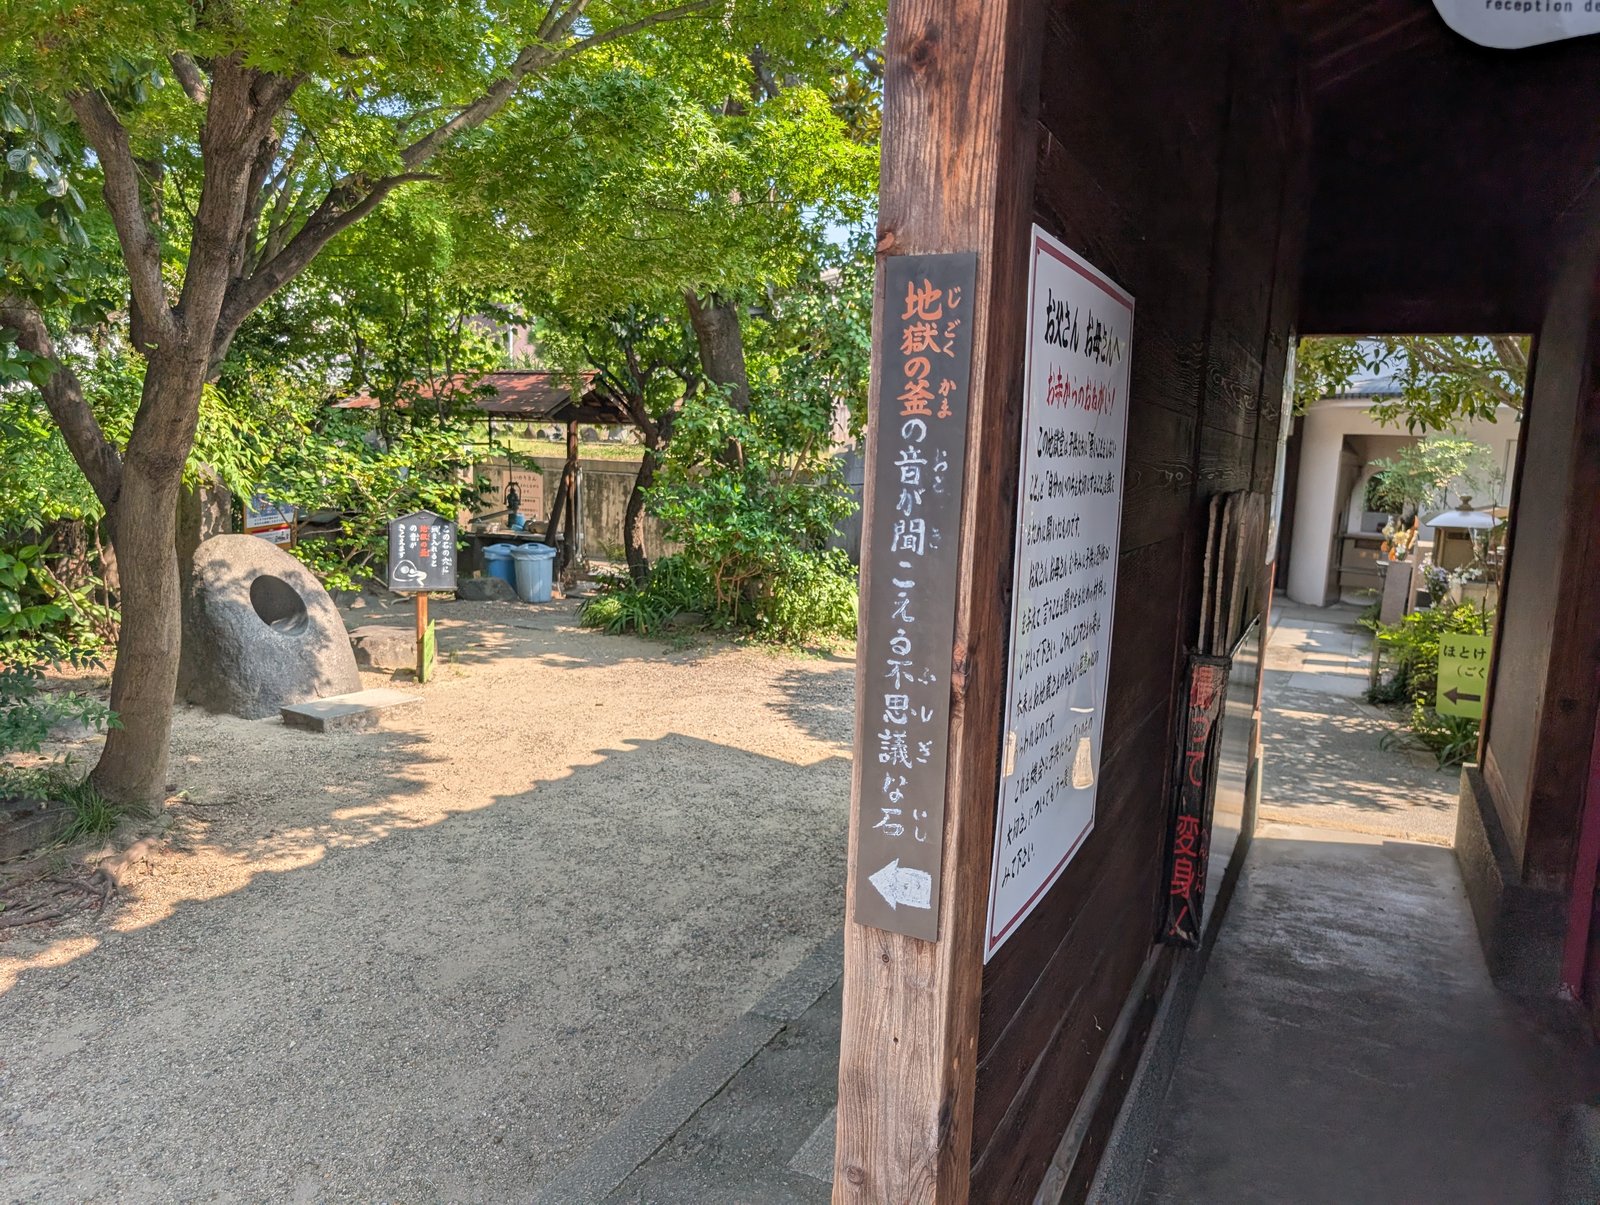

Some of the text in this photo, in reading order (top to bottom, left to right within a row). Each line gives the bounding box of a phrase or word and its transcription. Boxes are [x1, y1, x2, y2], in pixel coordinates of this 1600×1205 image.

[1486, 0, 1573, 13] reception
[942, 287, 962, 358] じごく
[1044, 288, 1121, 367] お父さん お母さんへ
[936, 378, 957, 419] かま
[1443, 645, 1487, 660] ほとけ
[912, 807, 928, 842] いし
